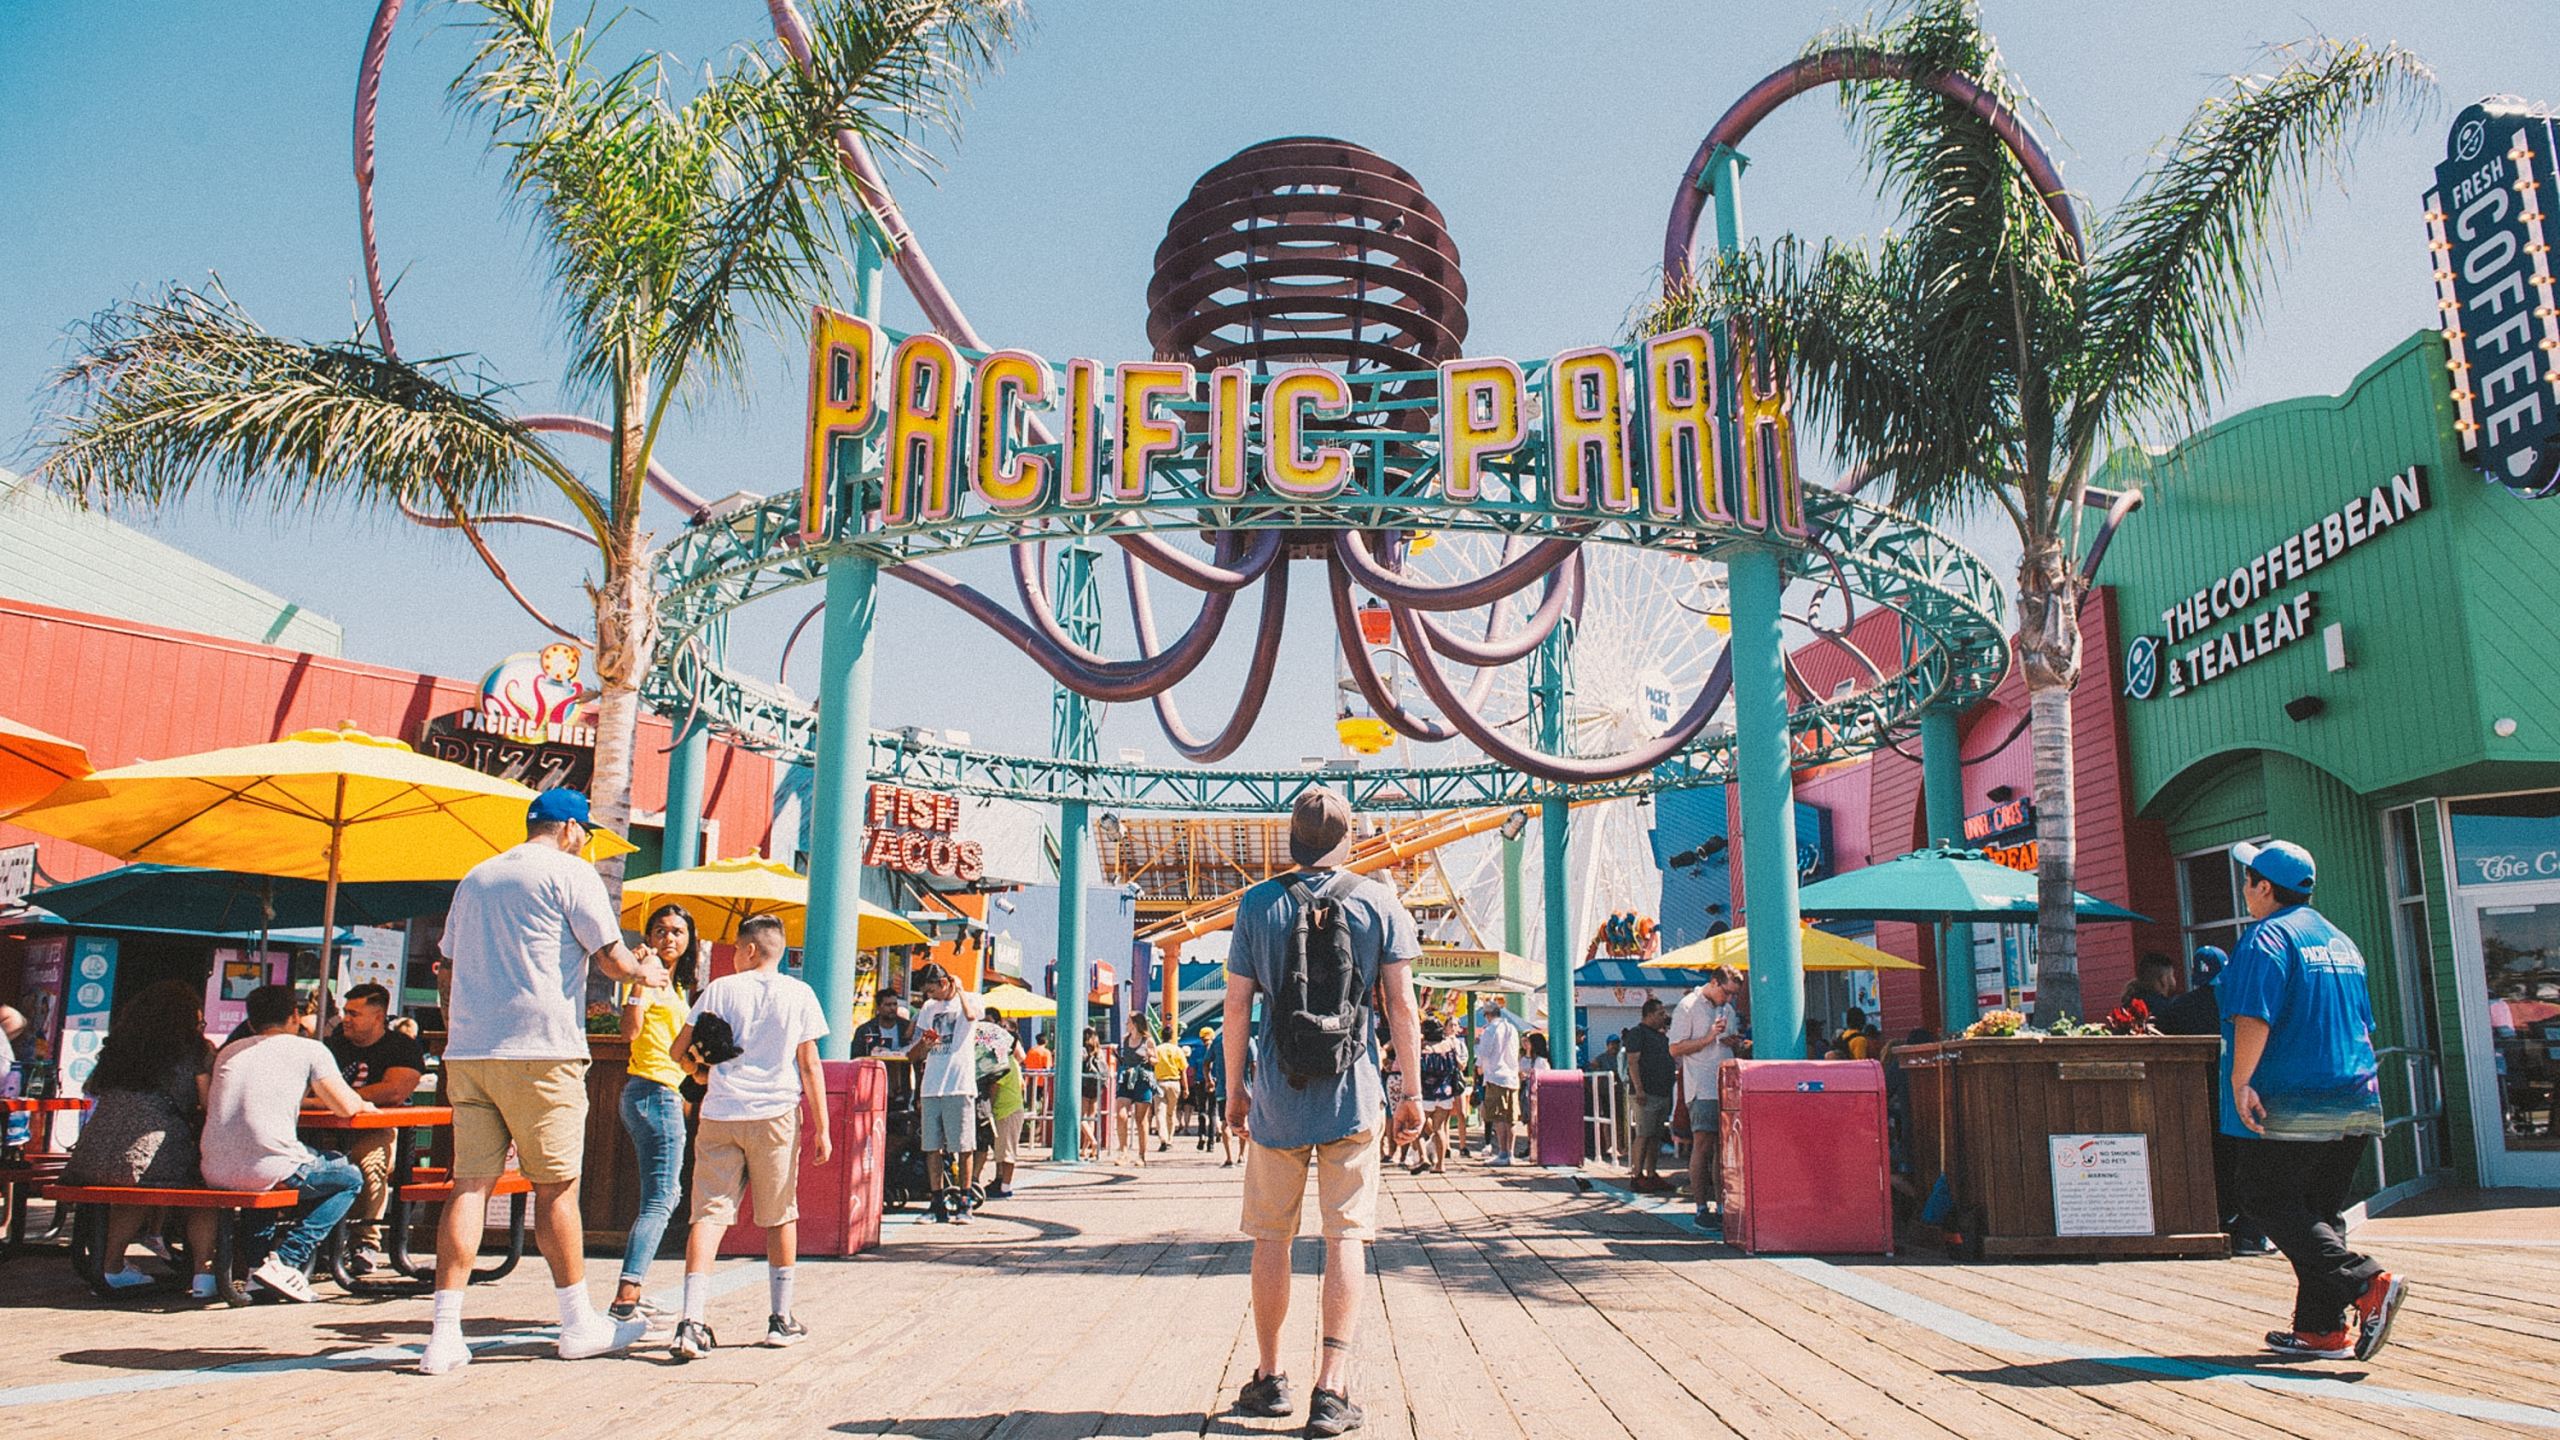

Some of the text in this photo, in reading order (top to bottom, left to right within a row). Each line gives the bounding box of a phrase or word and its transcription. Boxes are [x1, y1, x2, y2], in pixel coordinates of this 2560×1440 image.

[2453, 156, 2504, 209] FRESH
[2457, 187, 2543, 447] COFFEE
[799, 305, 1807, 544] PACIFIC PARK
[2168, 658, 2186, 698] &
[461, 709, 597, 748] PACIFIC WHEE
[870, 784, 960, 832] FISH
[1963, 814, 1992, 841] UNNEL
[2476, 854, 2529, 881] The
[1417, 957, 1481, 969] #PACIFICPARK
